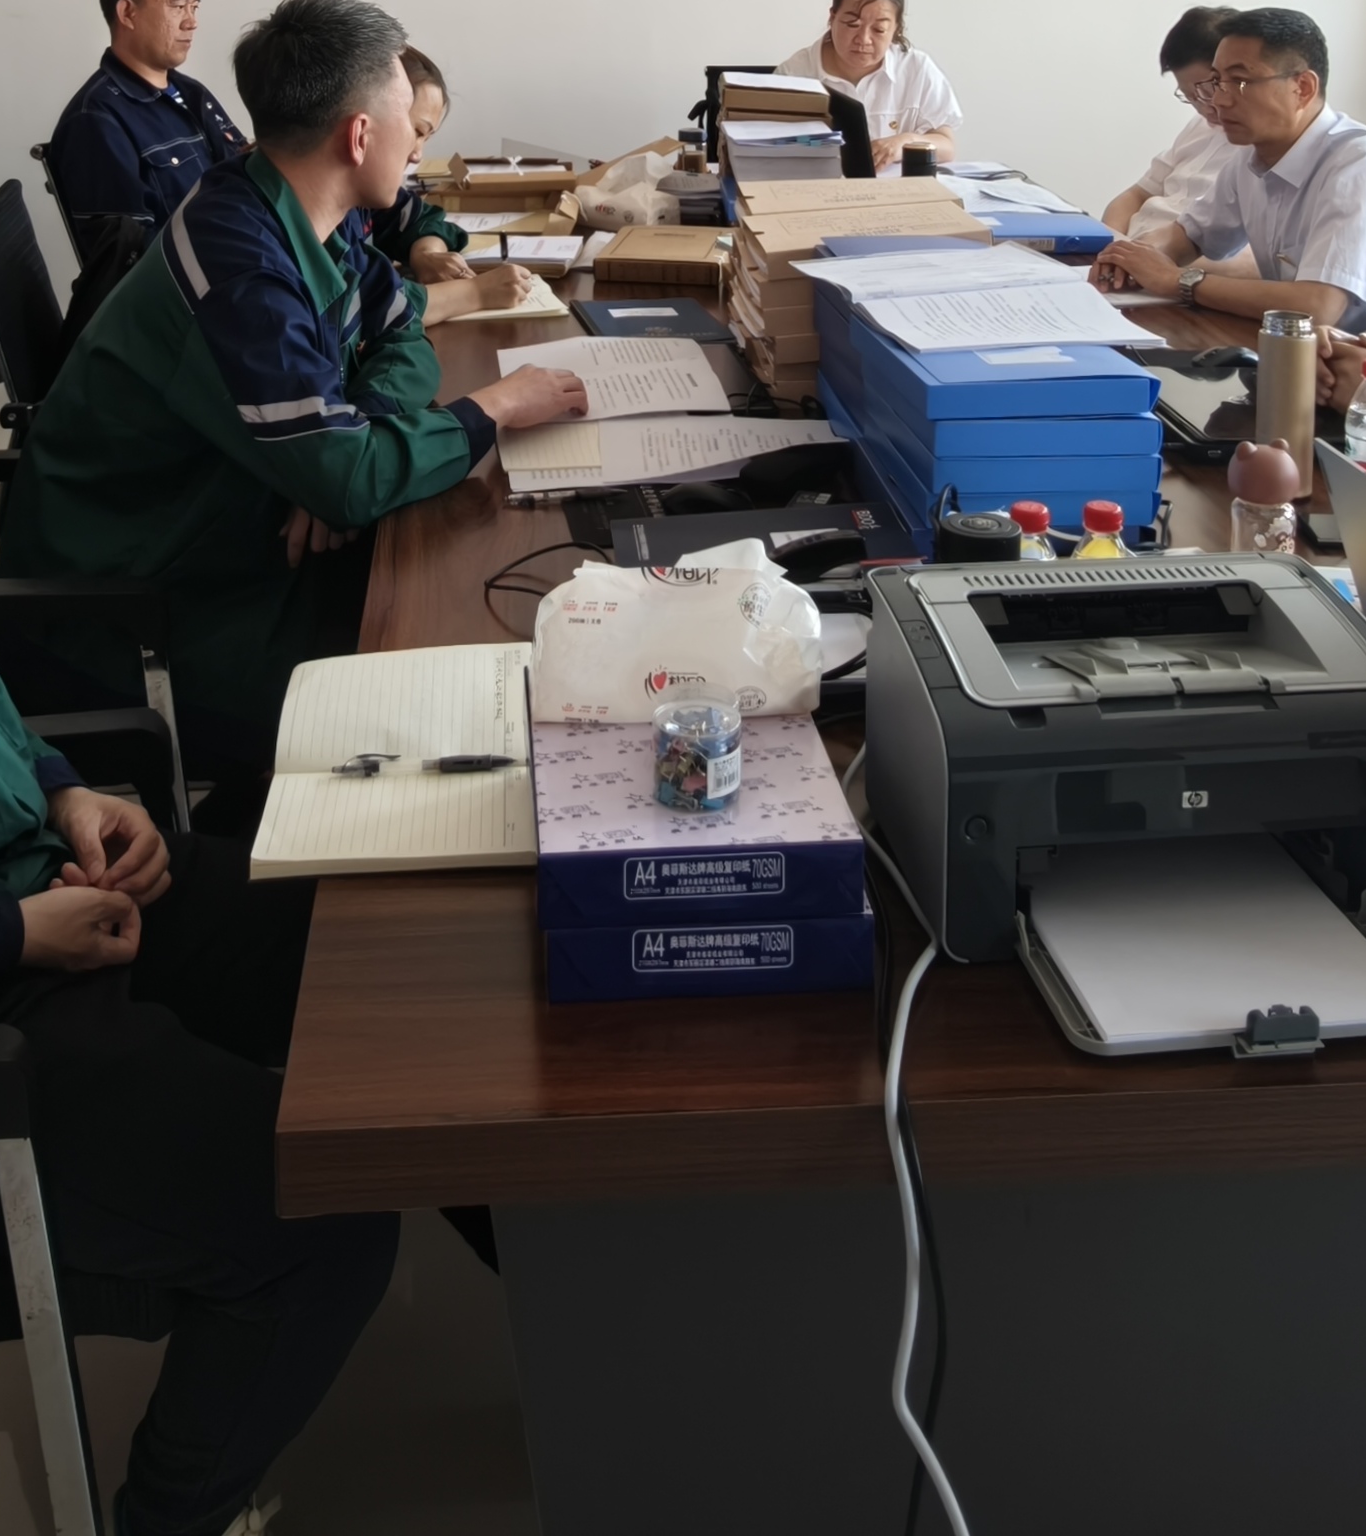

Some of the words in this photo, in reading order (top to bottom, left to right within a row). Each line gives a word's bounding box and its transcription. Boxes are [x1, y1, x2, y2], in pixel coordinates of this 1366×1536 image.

[635, 861, 656, 885] A4
[752, 858, 781, 878] 70GSM
[643, 933, 665, 958] A4
